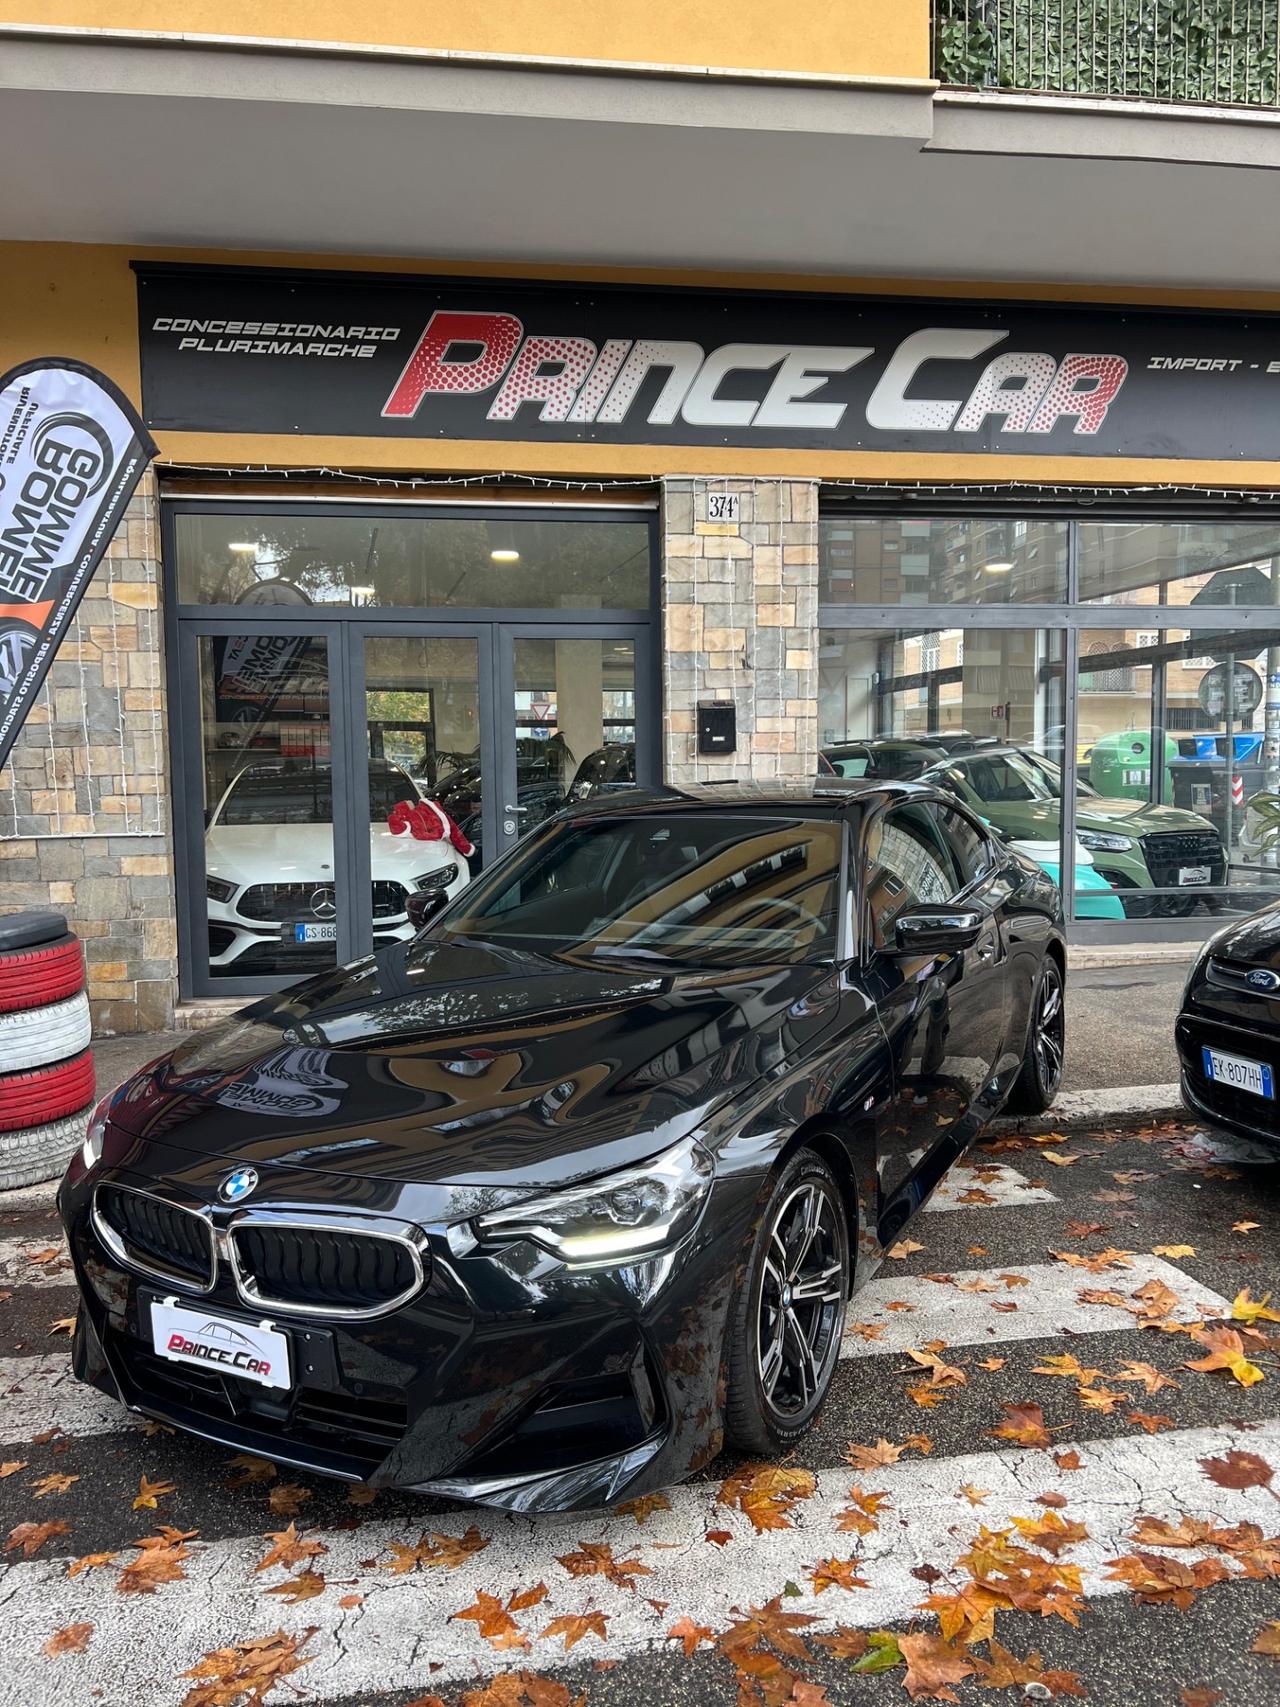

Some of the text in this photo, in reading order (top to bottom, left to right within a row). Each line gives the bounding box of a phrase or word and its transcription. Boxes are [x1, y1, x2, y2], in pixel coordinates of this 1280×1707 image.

[152, 318, 400, 340] CONCESSIONARIO
[179, 338, 377, 358] PLURIMARCHE
[381, 310, 1128, 434] PRINCE CAR
[1147, 357, 1243, 371] IMPORT
[168, 1334, 271, 1376] PRINCE CAR
